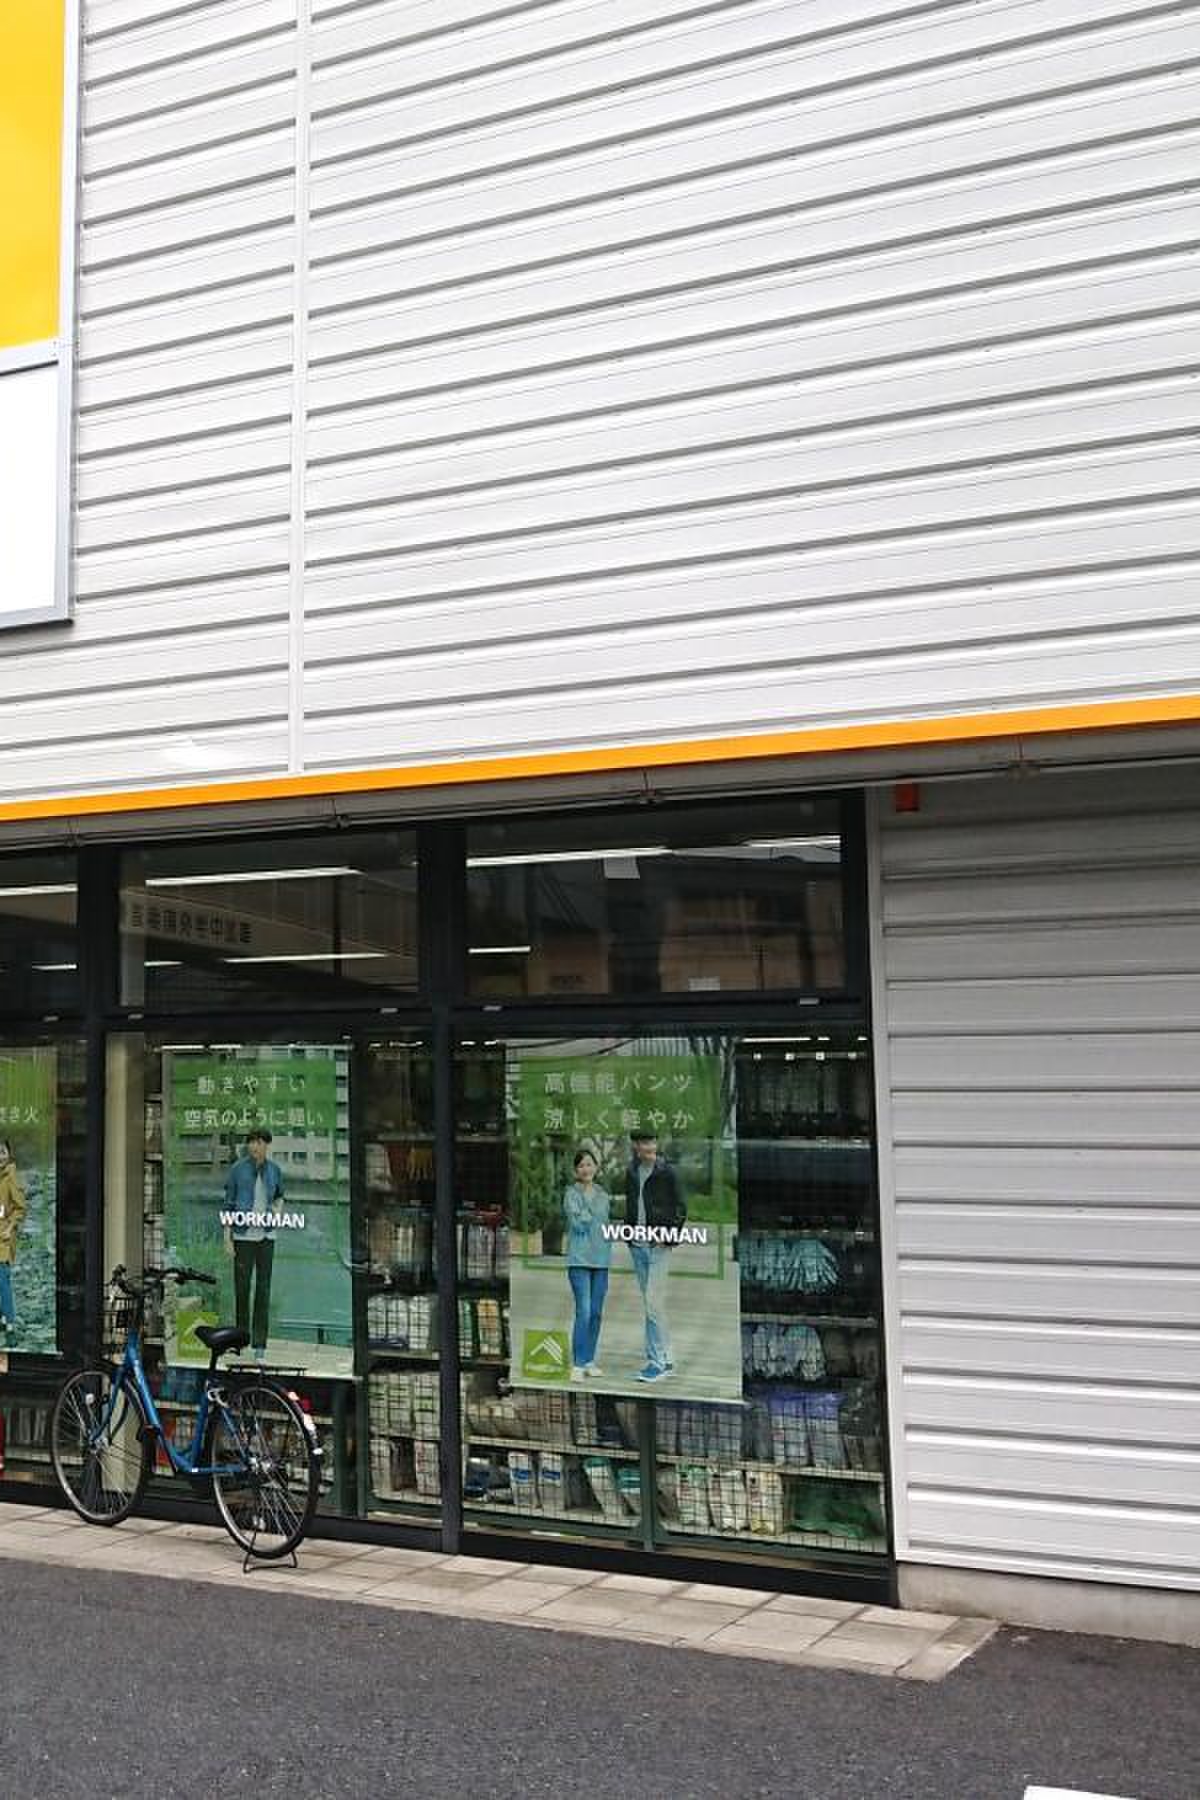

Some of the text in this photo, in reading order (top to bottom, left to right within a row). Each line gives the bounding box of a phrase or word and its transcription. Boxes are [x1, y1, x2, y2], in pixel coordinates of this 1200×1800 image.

[196, 1074, 306, 1096] 動きやすい
[543, 1107, 695, 1130] 涼しく軽やか
[219, 1209, 306, 1230] WORKMAN
[600, 1222, 709, 1245] WORKMAN
